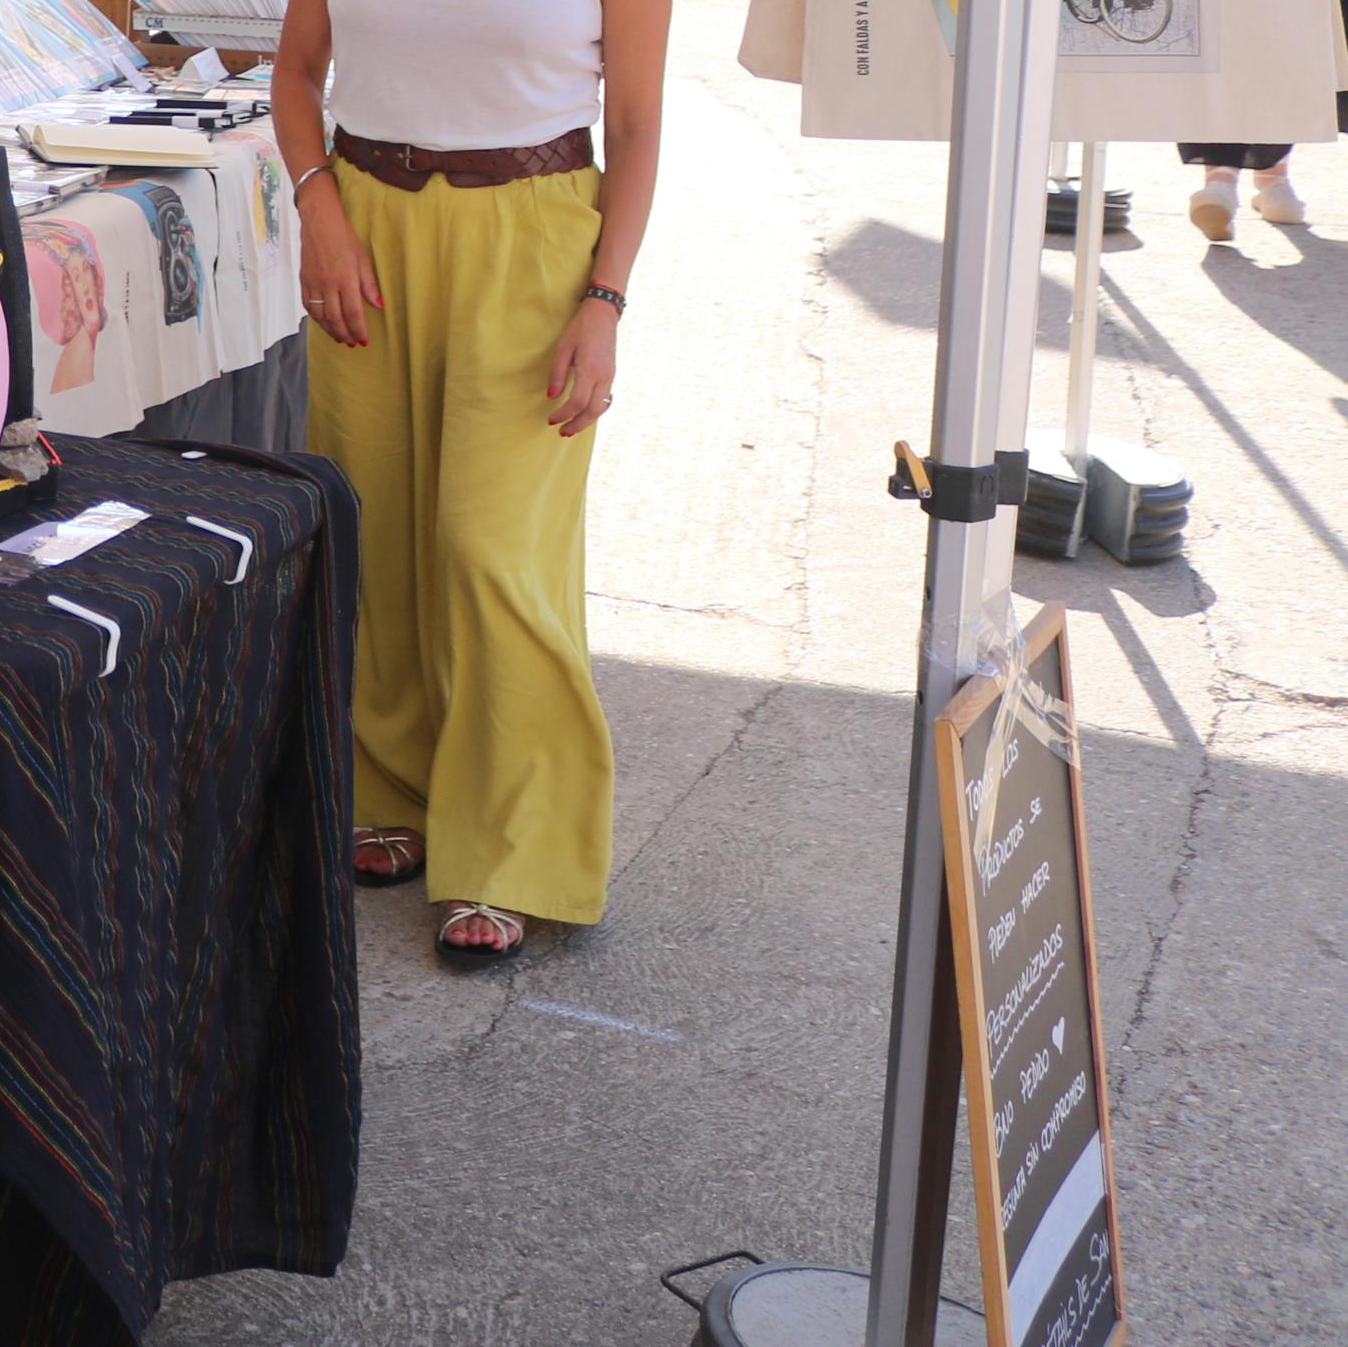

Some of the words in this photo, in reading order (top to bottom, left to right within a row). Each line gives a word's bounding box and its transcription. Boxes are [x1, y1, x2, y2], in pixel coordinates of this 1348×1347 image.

[145, 17, 164, 29] CM
[856, 19, 869, 54] FALDAS
[856, 56, 870, 76] CON
[1002, 738, 1019, 779] LOS
[1020, 861, 1050, 916] HACER
[1040, 1070, 1086, 1153] COMPROMISO
